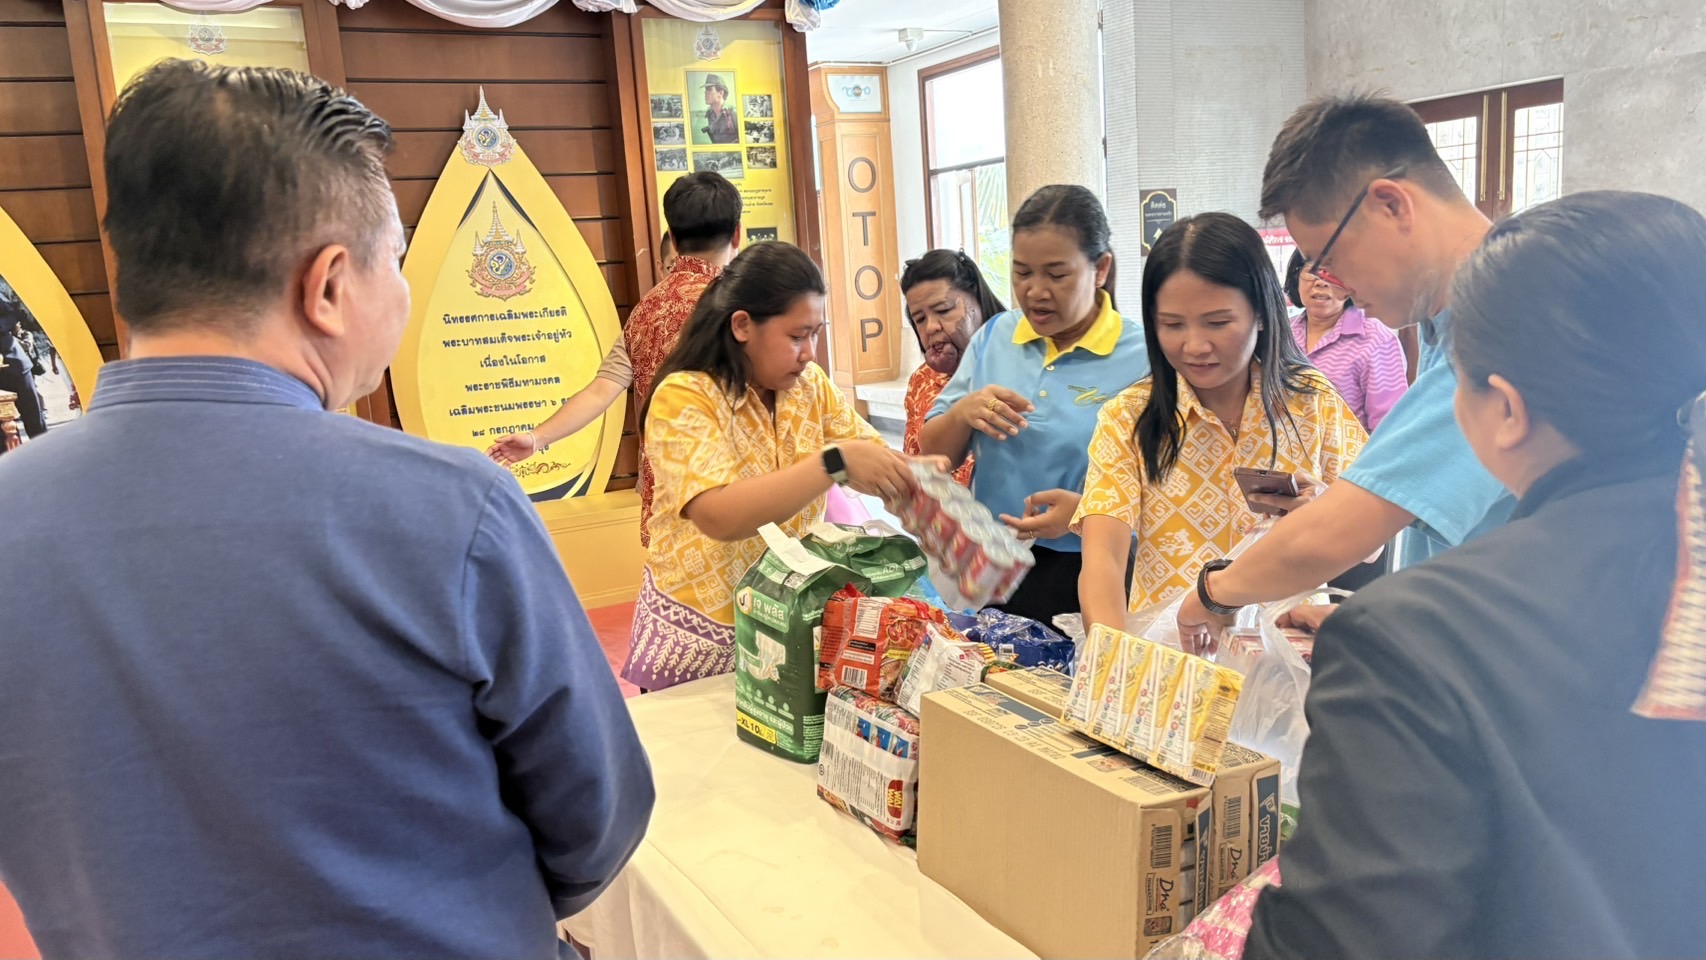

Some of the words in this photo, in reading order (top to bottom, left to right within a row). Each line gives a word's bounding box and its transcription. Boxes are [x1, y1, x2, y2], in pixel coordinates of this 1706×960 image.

[848, 157, 884, 352] OTOP
[442, 306, 568, 325] นิทรรศการเฉลิมพระเกียรติ
[442, 328, 573, 348] พระบาทสมเด็จพระเจ้าอยู่หัว
[479, 354, 546, 368] เนื่องในโอกาส
[464, 375, 561, 392] พระราชพิธีมหามงคล
[449, 400, 548, 417] เฉลิมพระชนมพรรษา
[489, 422, 535, 435] กรกฎาคม
[887, 788, 896, 807] WAI
[894, 790, 903, 809] WAI
